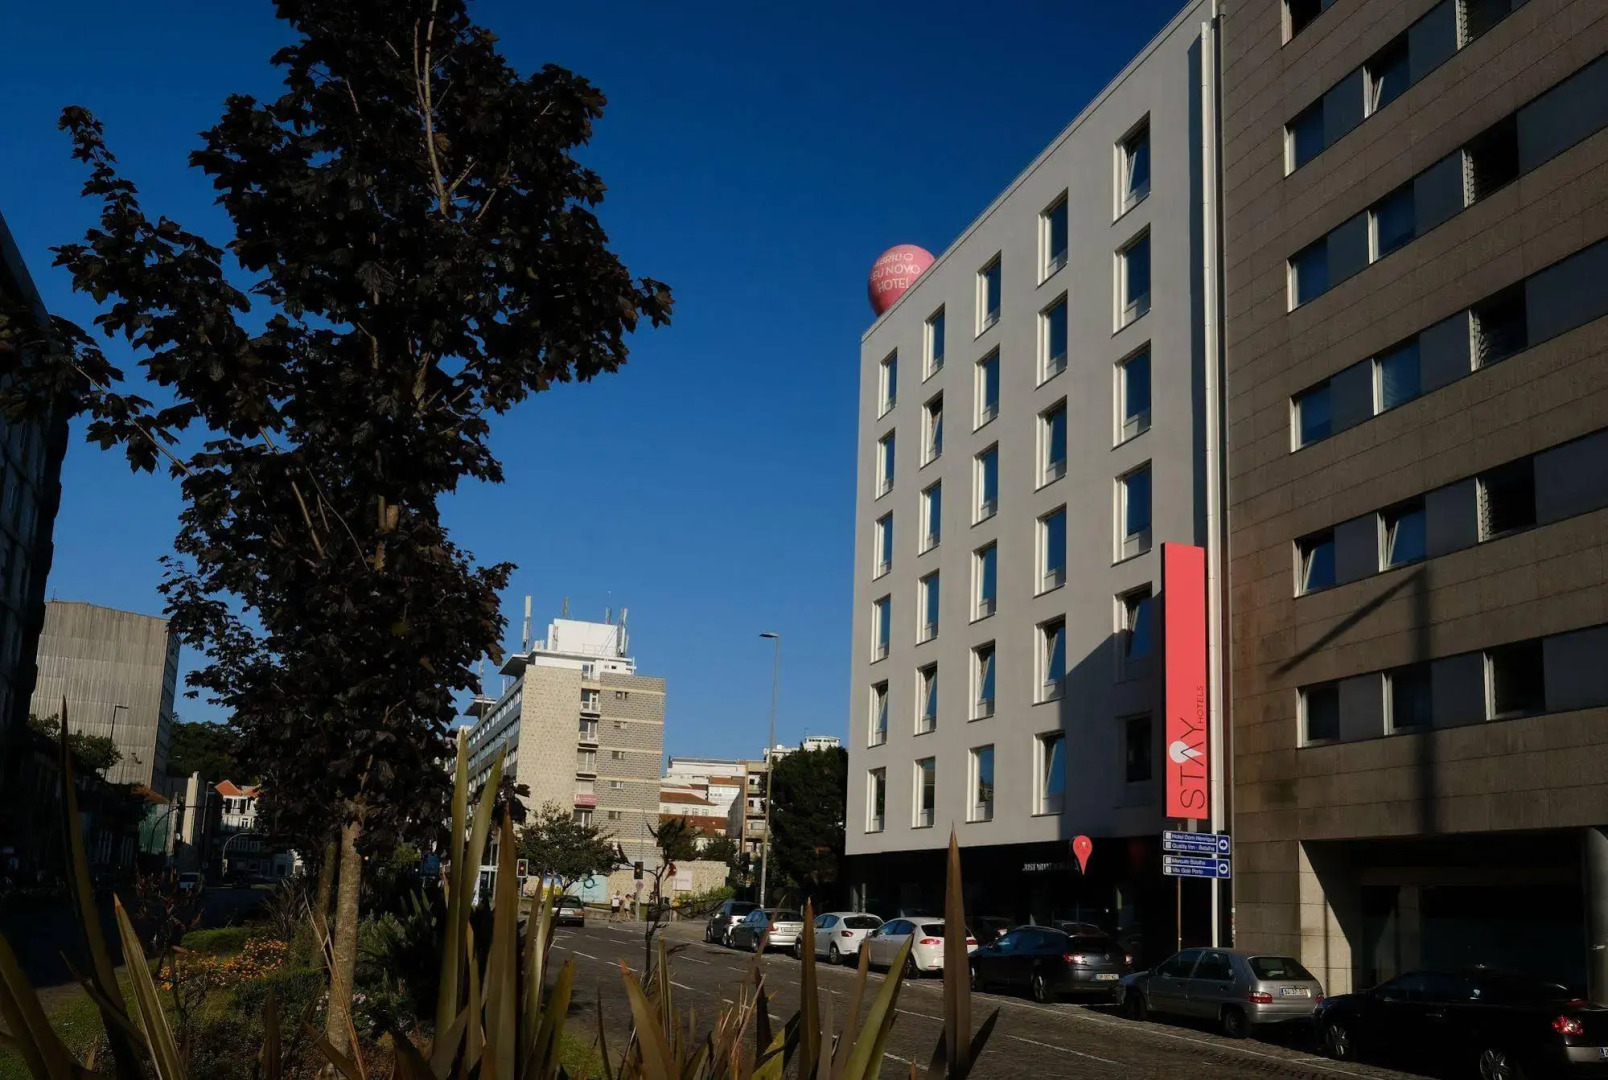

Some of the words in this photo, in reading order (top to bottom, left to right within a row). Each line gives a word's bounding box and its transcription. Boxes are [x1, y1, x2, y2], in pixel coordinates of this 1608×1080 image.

[903, 252, 914, 262] O
[885, 264, 921, 276] NOVO
[877, 278, 909, 293] HOTEL
[1180, 717, 1205, 810] STAY
[1022, 863, 1036, 871] JUST
